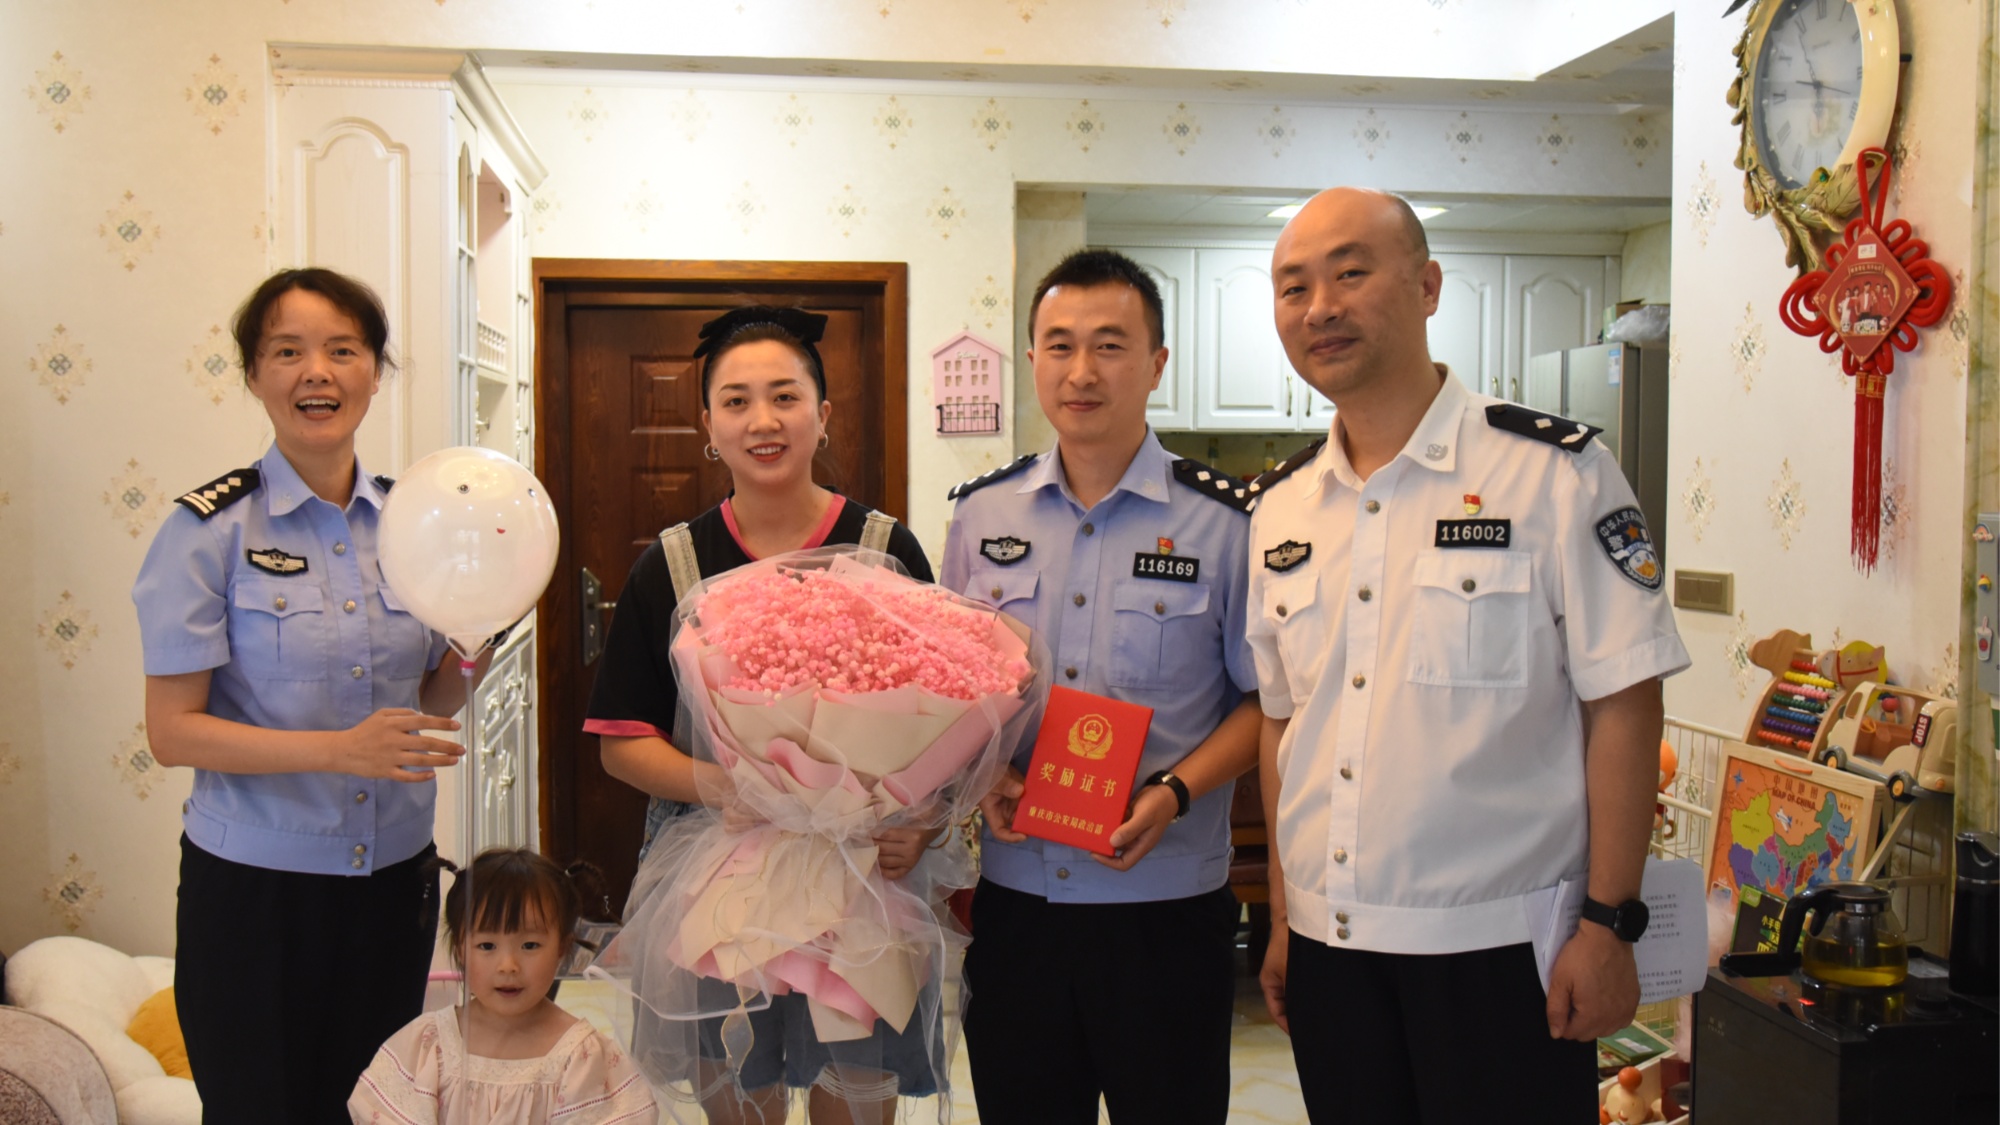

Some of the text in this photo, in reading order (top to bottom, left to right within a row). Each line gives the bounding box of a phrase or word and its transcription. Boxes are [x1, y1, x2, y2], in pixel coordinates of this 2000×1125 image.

[1441, 525, 1505, 542] 116002
[1600, 510, 1645, 537] 中华人民共
[1138, 557, 1195, 577] 116169
[1915, 716, 1928, 743] STOP
[1040, 762, 1117, 797] 奖励证书
[1772, 787, 1816, 810] MAP OF CHINA
[1028, 806, 1104, 835] 重庆市公安局政治部
